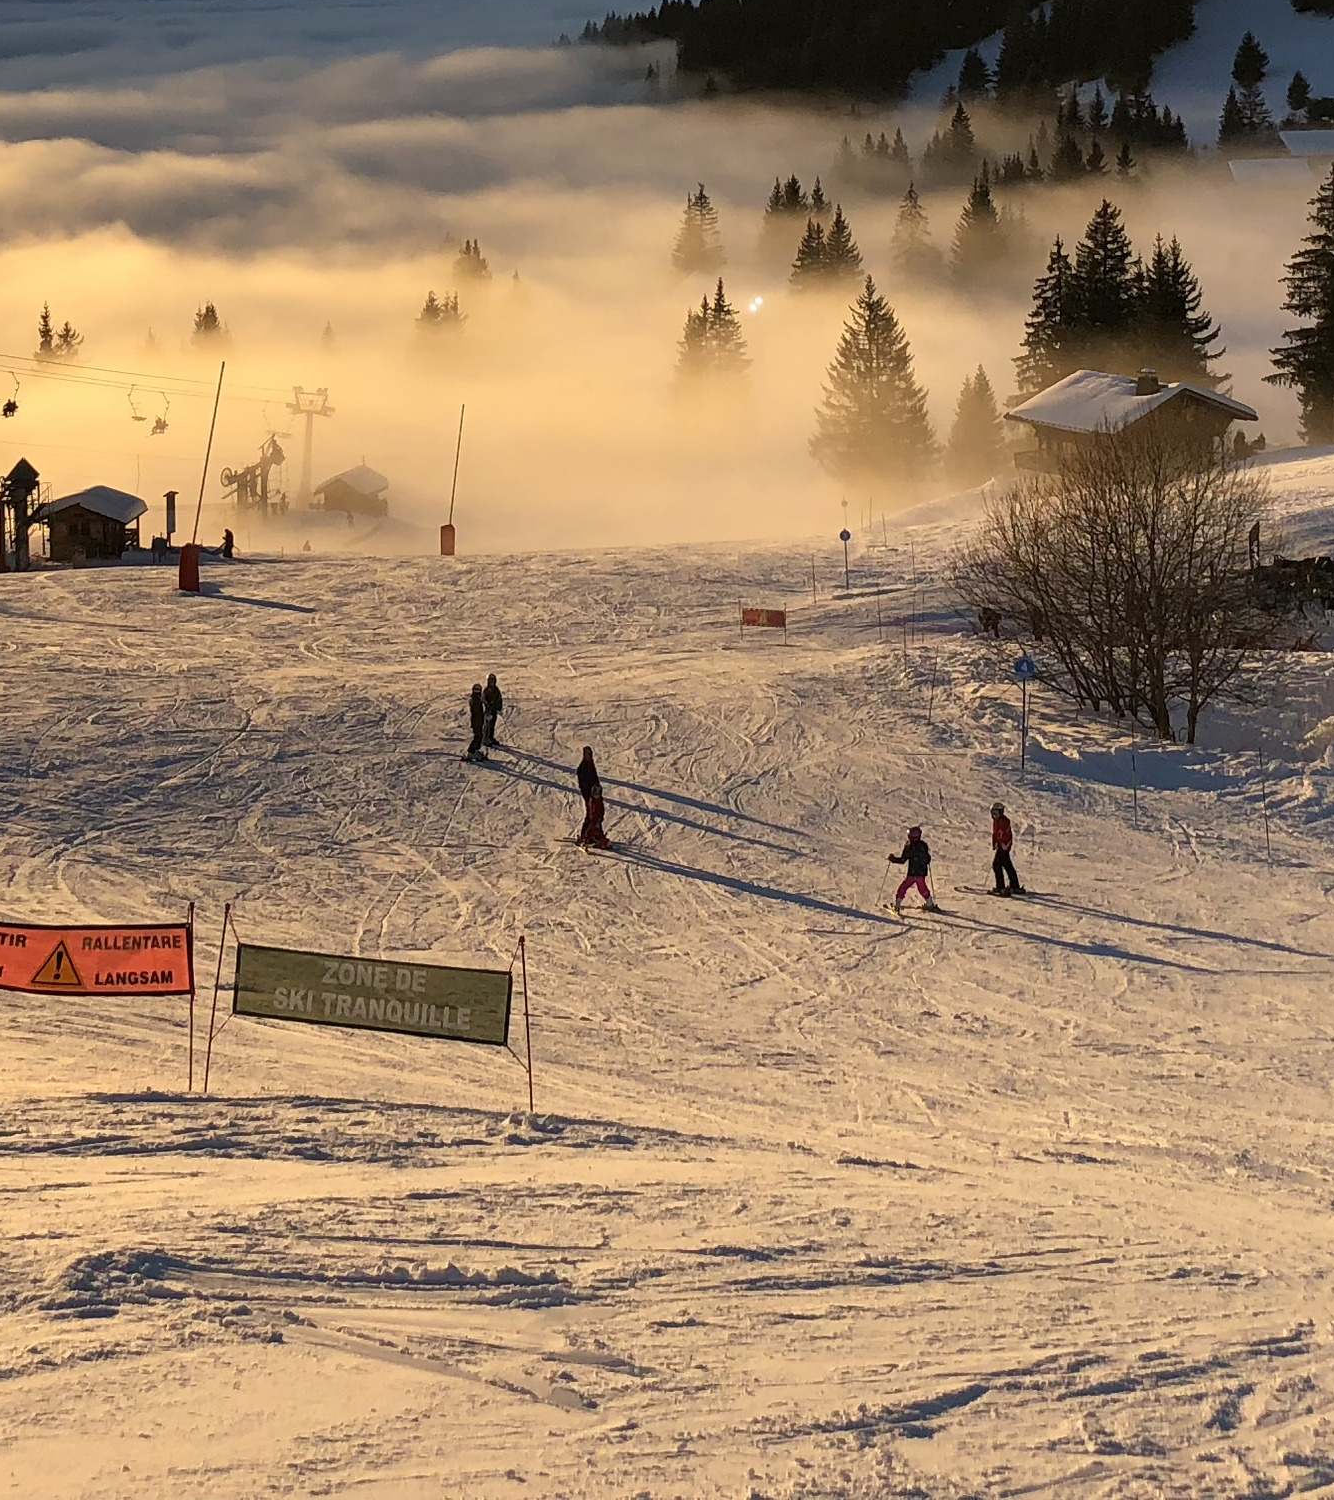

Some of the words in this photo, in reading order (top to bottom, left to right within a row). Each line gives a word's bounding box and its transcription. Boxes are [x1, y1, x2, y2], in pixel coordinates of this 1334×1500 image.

[82, 935, 182, 950] RALLENTARE
[94, 970, 174, 986] LANGSAM
[322, 961, 388, 988] ZONE
[396, 968, 427, 993] DE
[273, 987, 314, 1013] SKI
[322, 992, 471, 1030] TRANQUILLE
